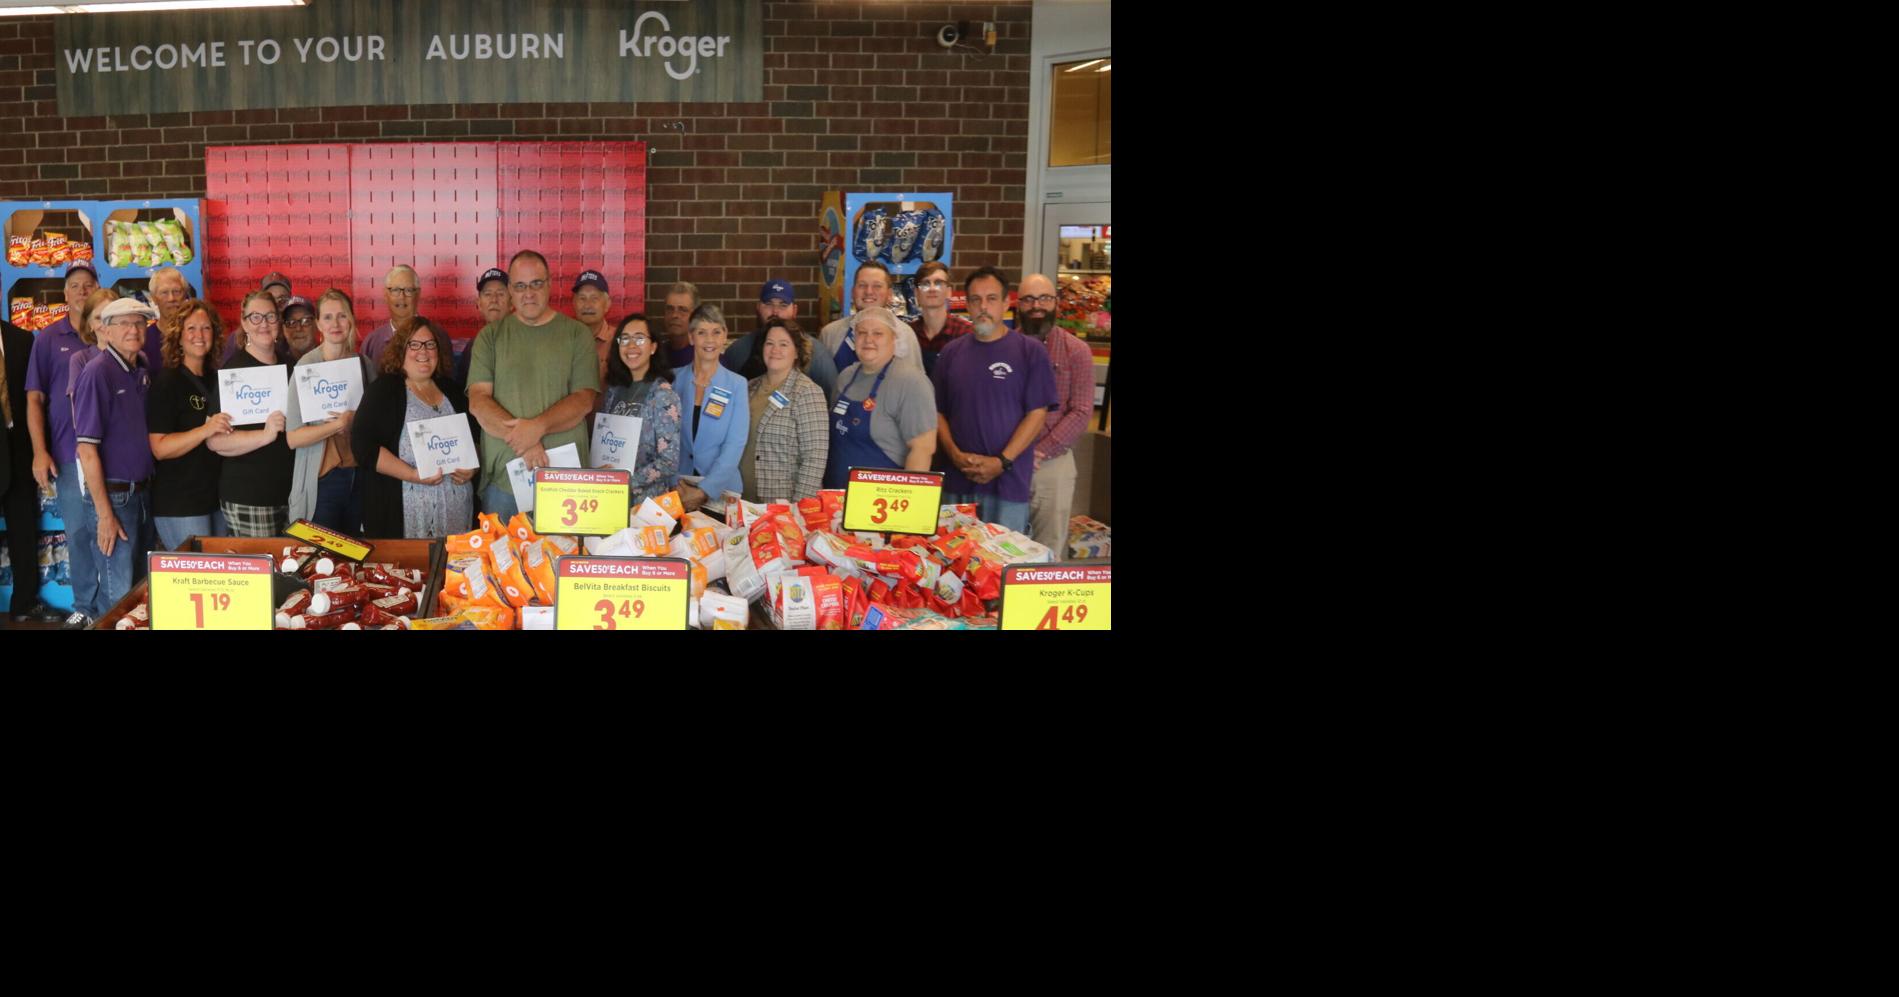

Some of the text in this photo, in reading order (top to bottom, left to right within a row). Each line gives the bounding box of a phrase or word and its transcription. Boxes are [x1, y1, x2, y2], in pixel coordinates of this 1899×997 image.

[64, 10, 731, 80] WELCOME TO YOUR AUBURN Kroger
[236, 384, 272, 405] Kroger
[313, 379, 348, 400] Kroger
[427, 435, 458, 456] Kroger
[601, 431, 626, 454] Kroger
[561, 498, 598, 527] 3 49
[870, 498, 909, 524] 3 49
[603, 583, 639, 591] Breakfast
[641, 584, 671, 592] Biscuits
[1040, 589, 1094, 597] Kroger K-Cups
[211, 593, 231, 610] 19
[593, 599, 645, 630] 3 49
[1062, 604, 1088, 623] 49
